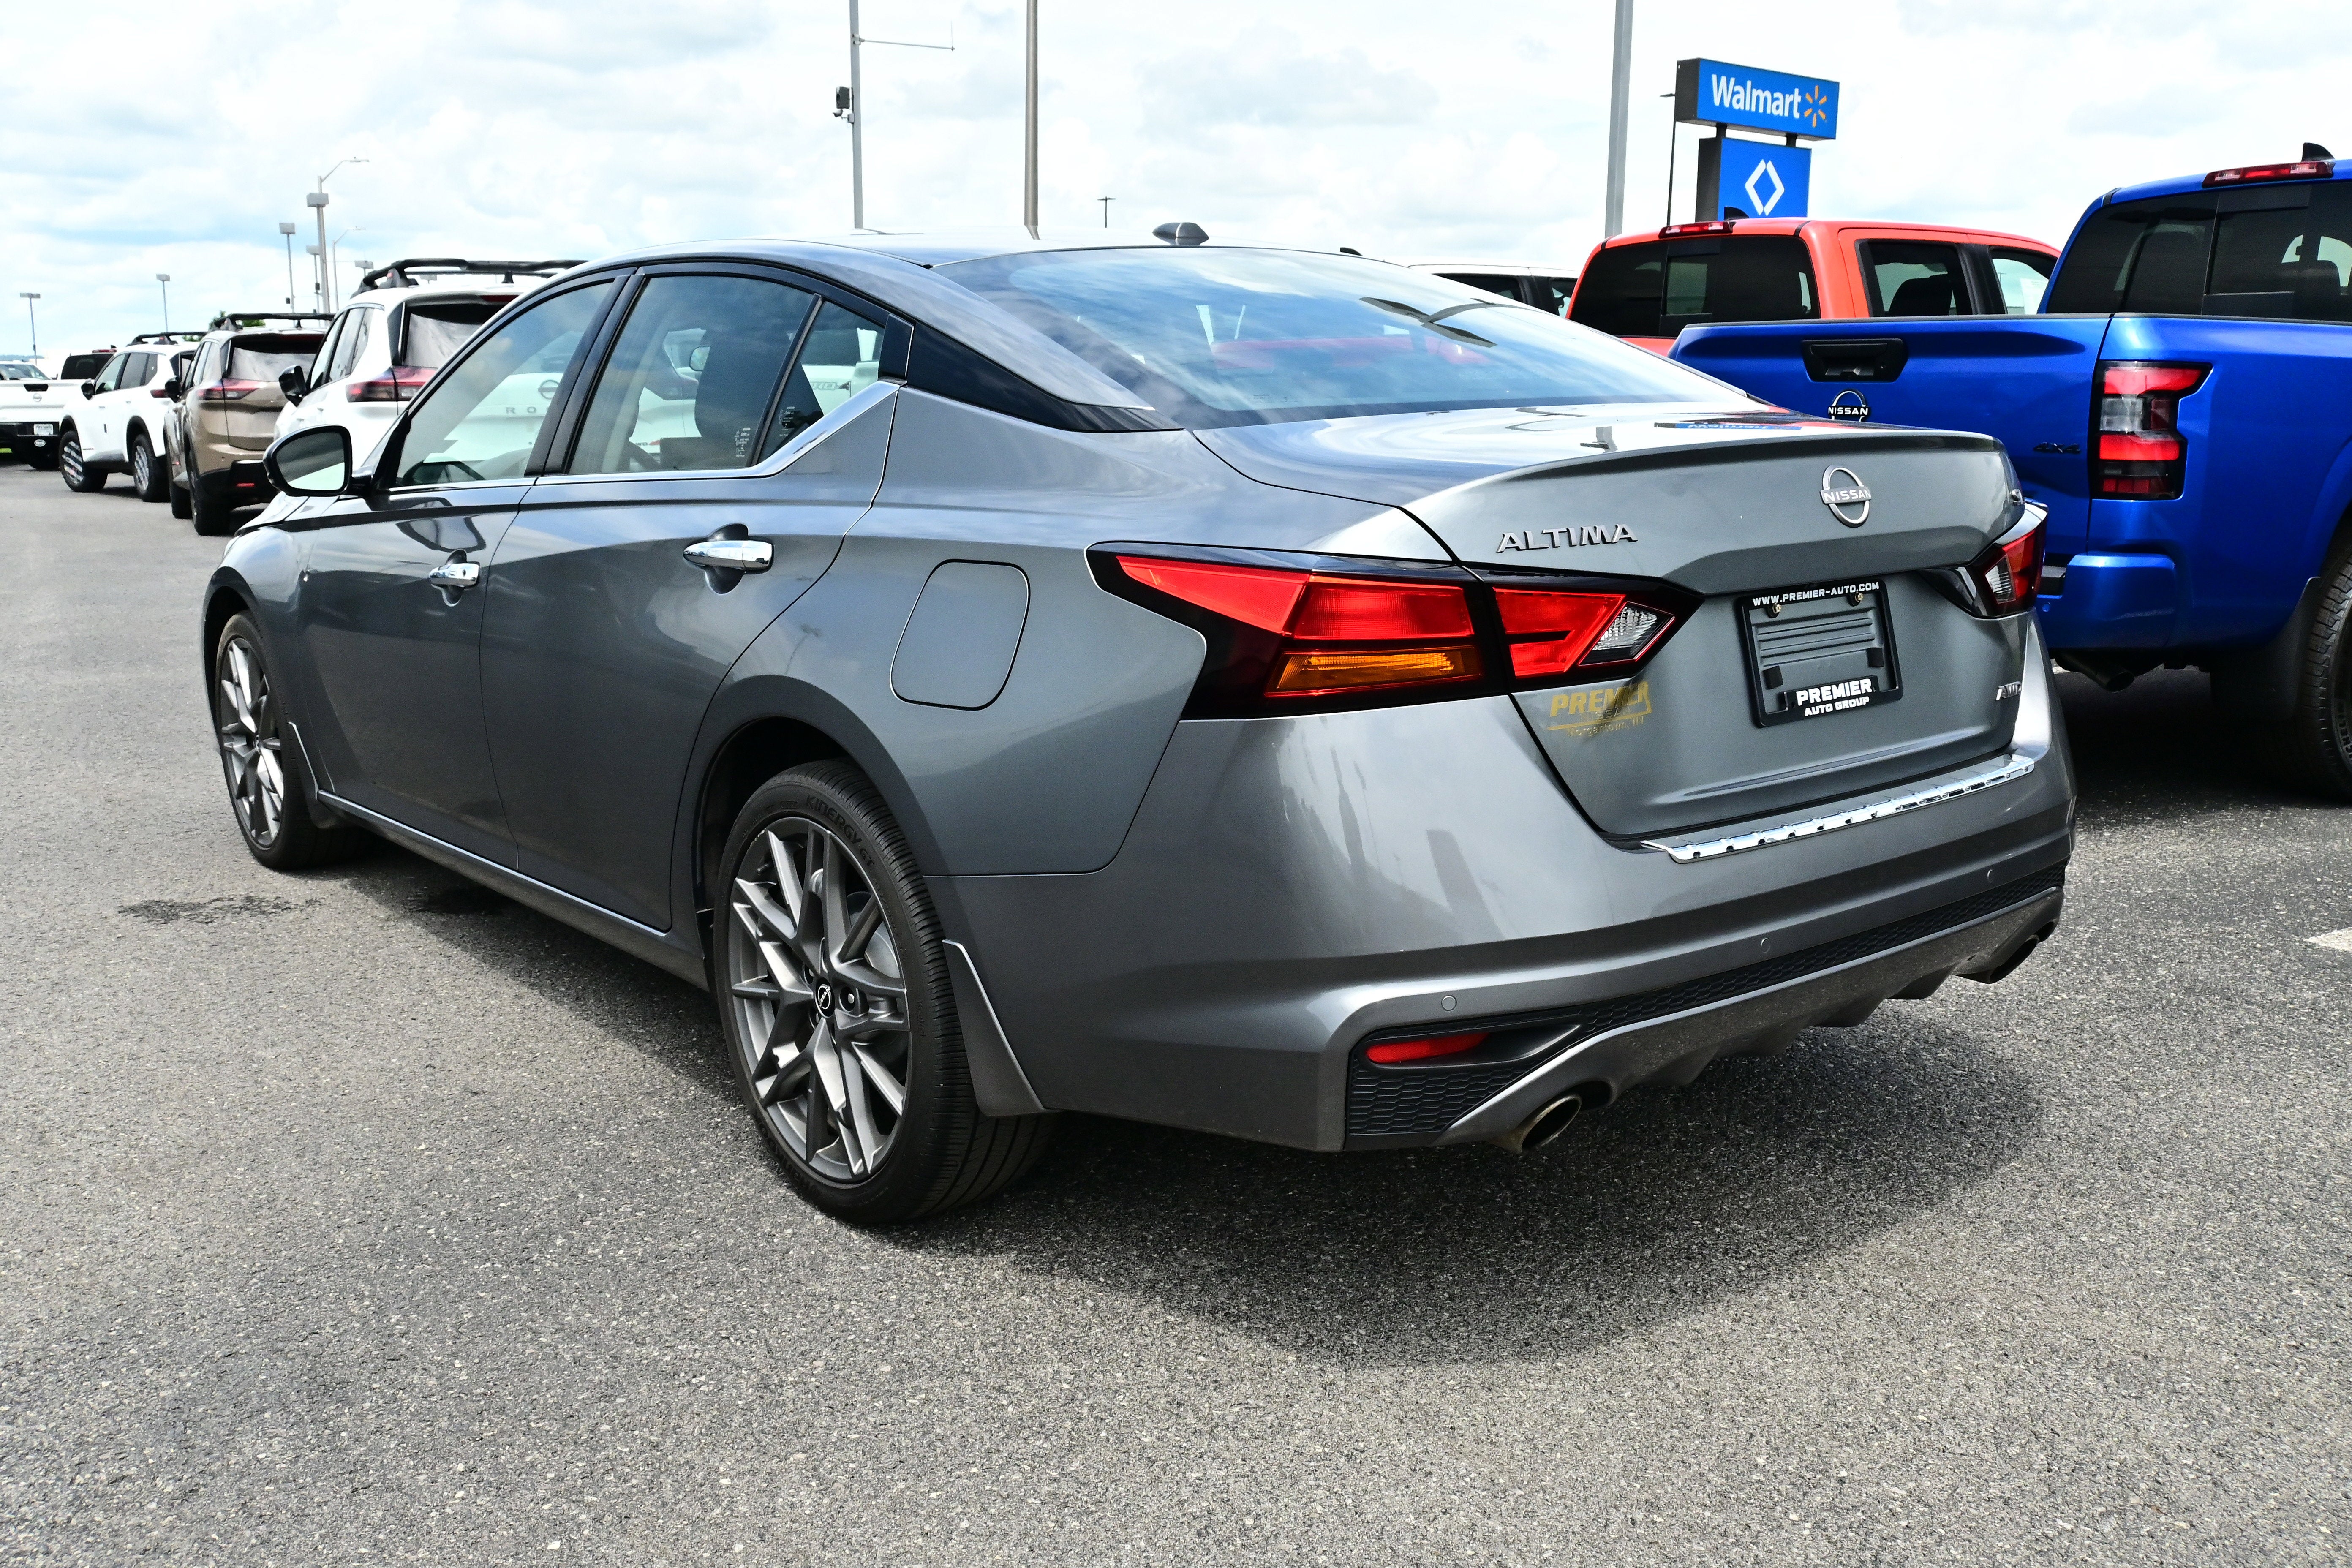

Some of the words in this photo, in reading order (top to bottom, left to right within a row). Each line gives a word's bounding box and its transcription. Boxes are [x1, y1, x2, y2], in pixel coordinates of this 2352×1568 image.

[1712, 74, 1802, 119] Walmart
[1828, 407, 1868, 415] NISSAN
[1823, 489, 1872, 502] NISSAN
[1496, 524, 1638, 553] ALTIMA
[1753, 582, 1879, 606] WWW.PREMIER-AUTO.COM
[1550, 681, 1652, 717] PREMIER
[1796, 678, 1872, 706] PREMIER
[1804, 703, 1833, 716] AUTO
[1835, 696, 1870, 710] GROUP
[806, 794, 863, 844] KINERGY
[860, 847, 875, 867] GT
